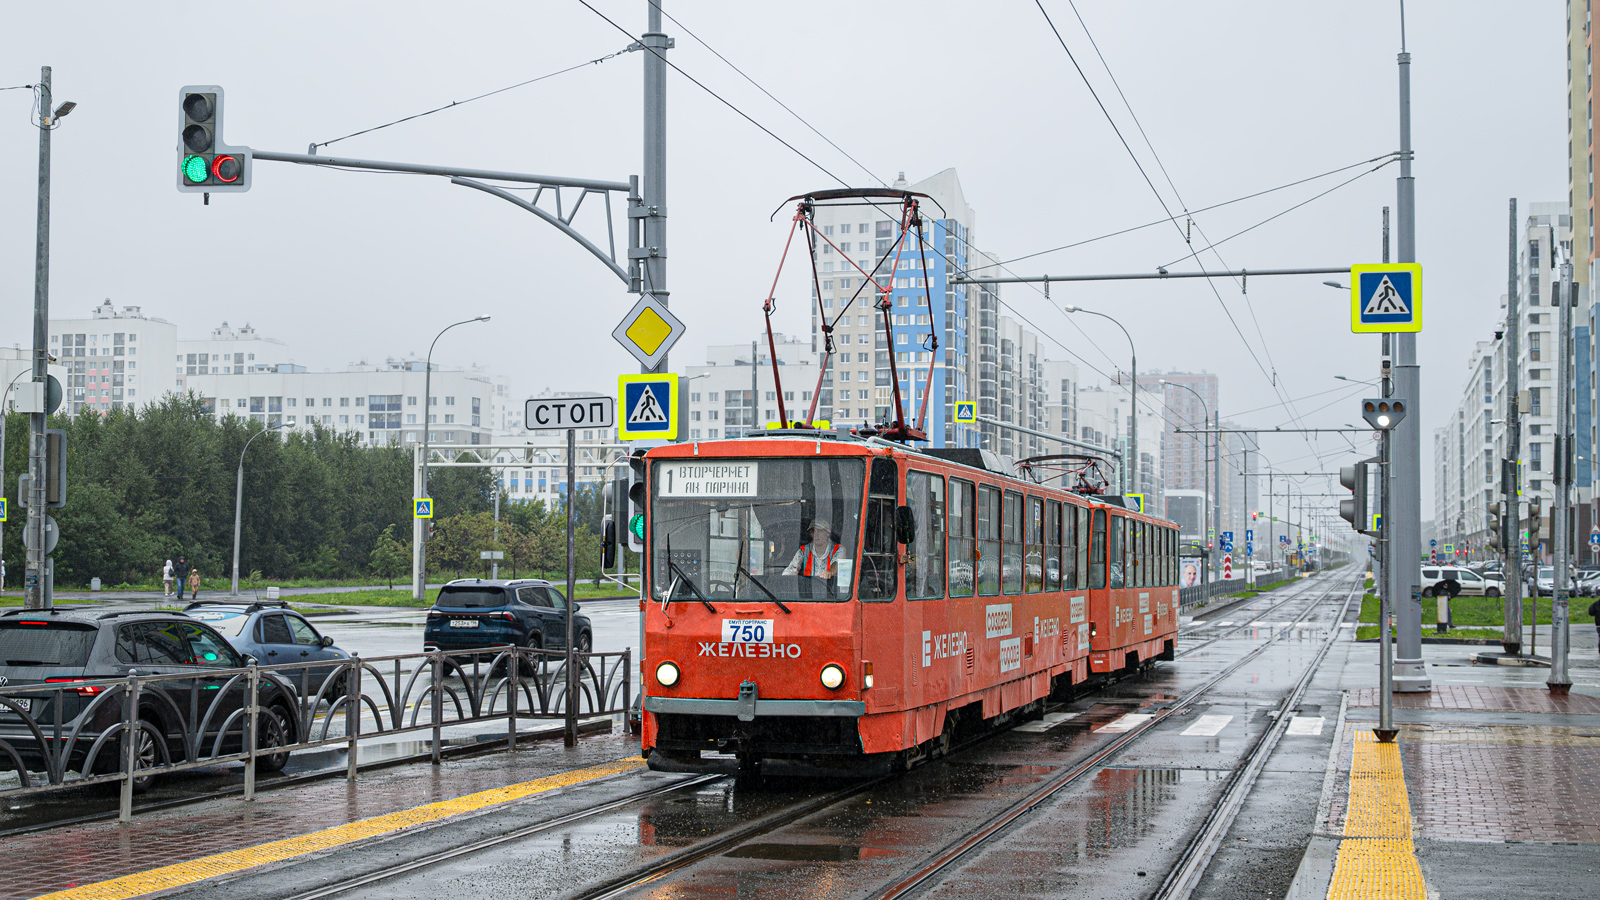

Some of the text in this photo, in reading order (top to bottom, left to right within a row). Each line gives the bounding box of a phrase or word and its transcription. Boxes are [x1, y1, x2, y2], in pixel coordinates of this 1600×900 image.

[535, 402, 604, 424] СТОП
[666, 466, 750, 493] 1 ВТОРЧЕРМЕТ
[729, 625, 765, 642] 750
[698, 642, 802, 658] ЖЕЛЕЗНО
[933, 631, 968, 660] ЖЕЛЕЗНО
